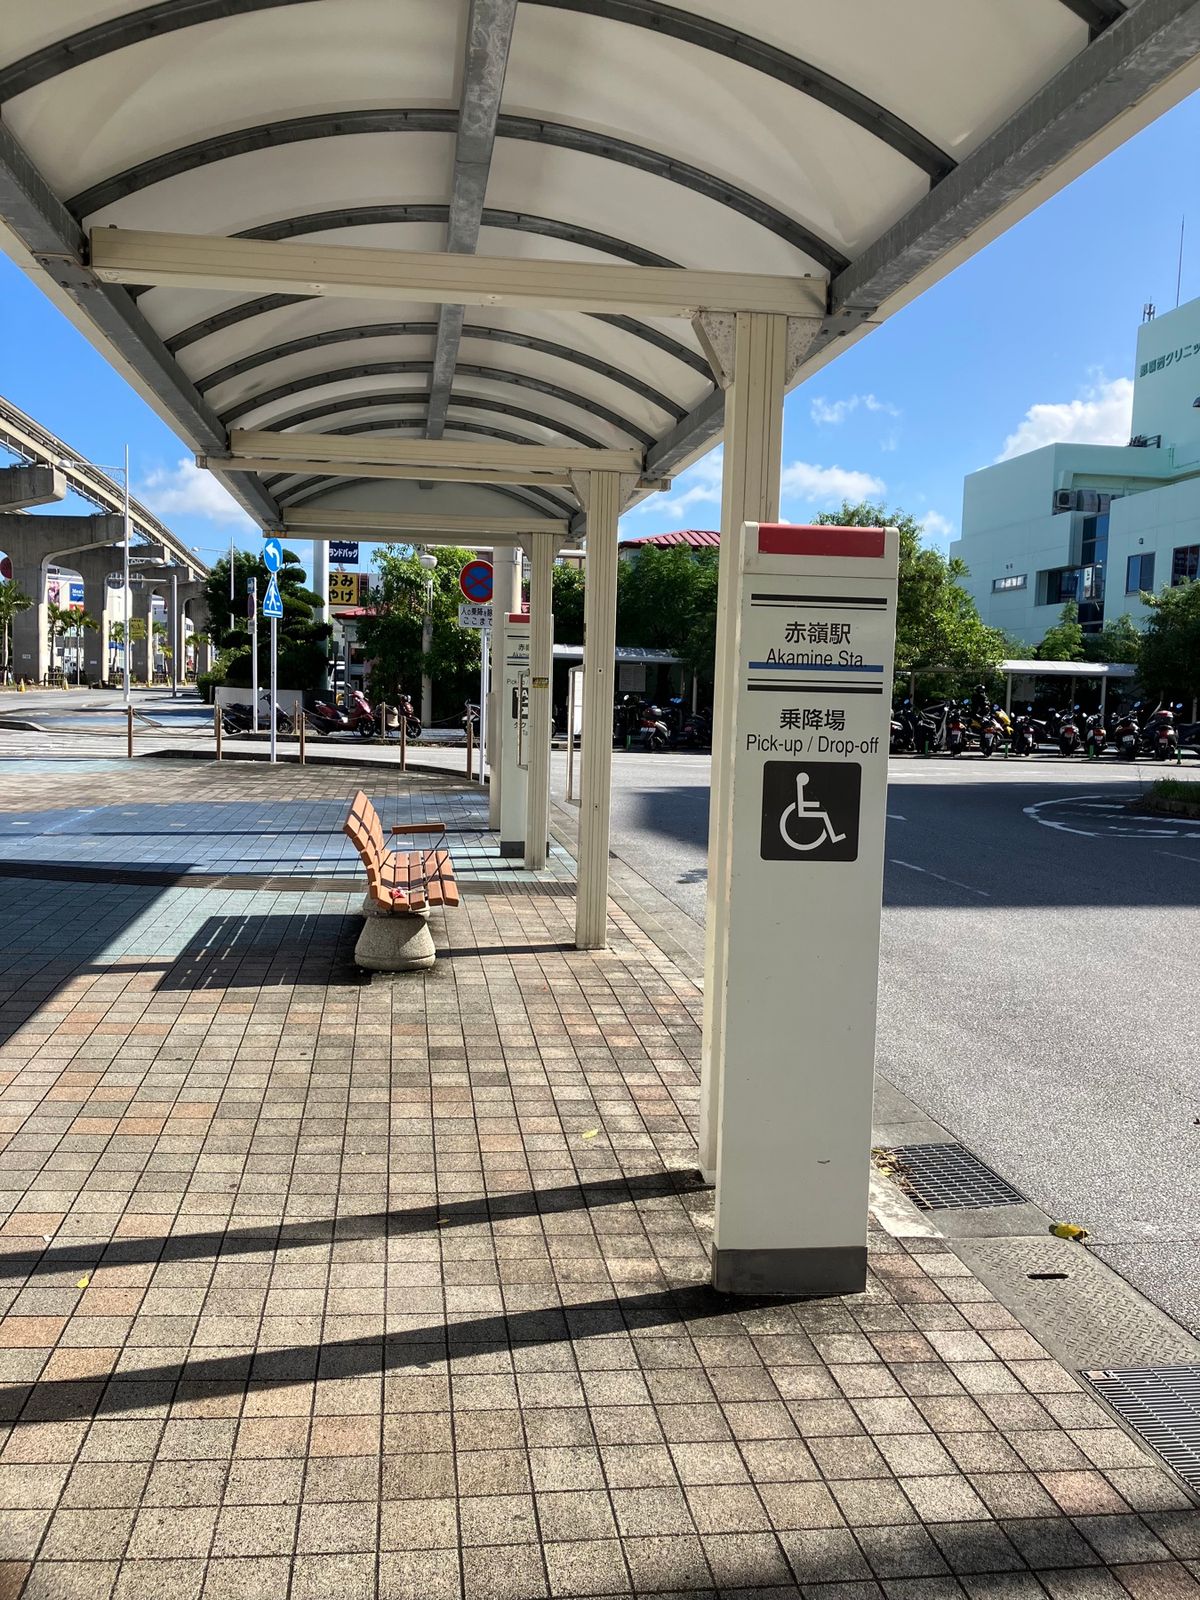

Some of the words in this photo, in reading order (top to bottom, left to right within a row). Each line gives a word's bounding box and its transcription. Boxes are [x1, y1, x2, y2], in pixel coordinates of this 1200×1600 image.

[329, 574, 354, 587] おみ
[784, 621, 851, 645] 赤嶺駅
[766, 648, 833, 667] Akamine
[838, 650, 868, 668] Sta.
[779, 708, 846, 731] 乗降場
[746, 734, 803, 756] Pick-up
[807, 735, 813, 753] /
[818, 735, 879, 758] Drop-off
